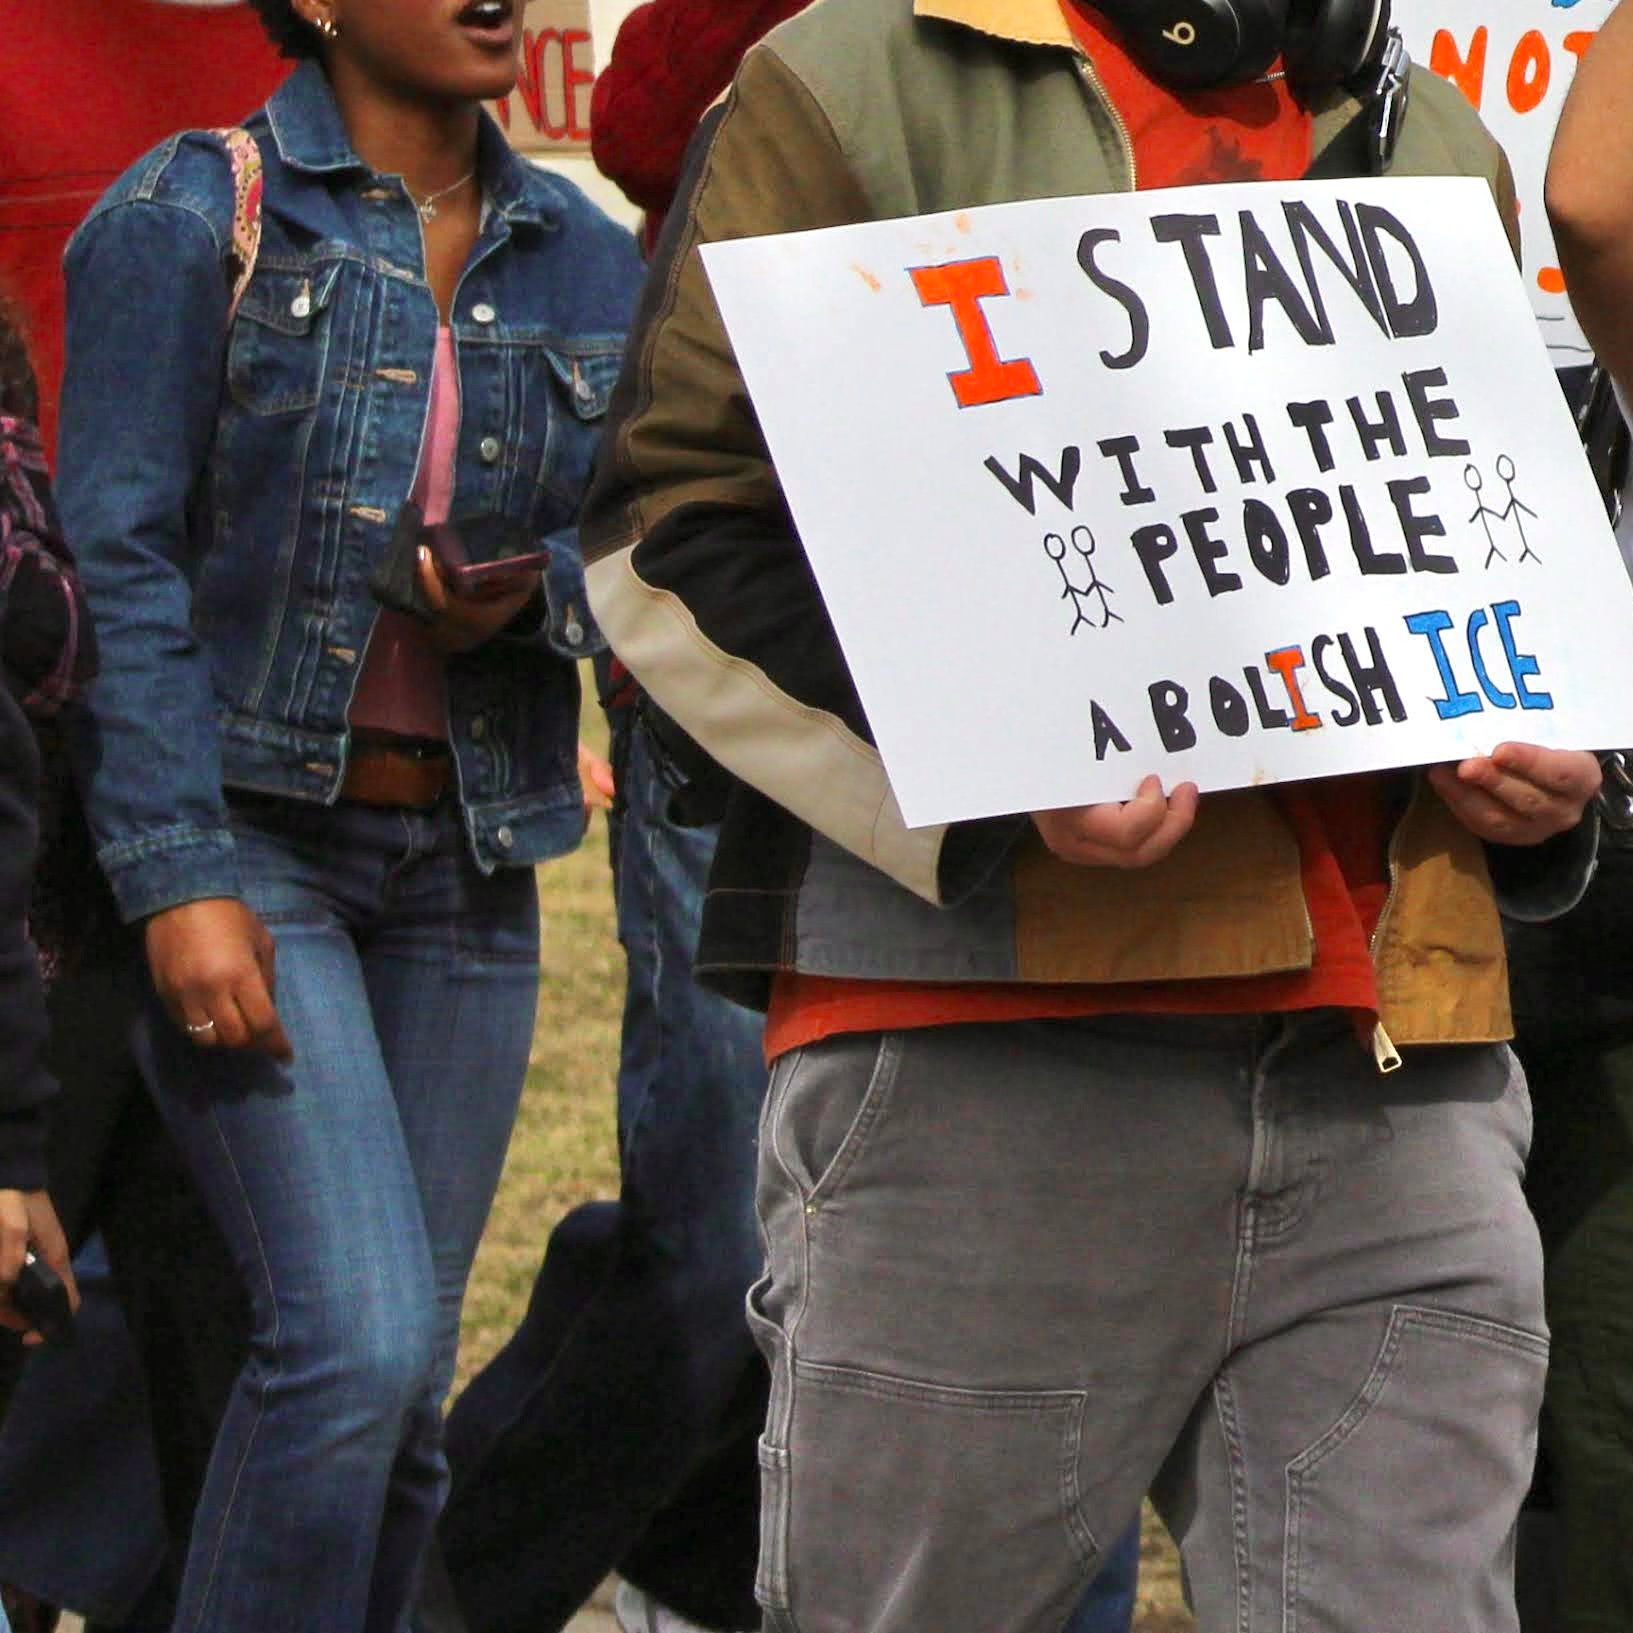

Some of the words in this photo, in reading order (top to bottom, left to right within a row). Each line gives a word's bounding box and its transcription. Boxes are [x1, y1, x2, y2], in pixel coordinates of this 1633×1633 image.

[905, 255, 1043, 410] I
[1076, 199, 1439, 370] STAND
[983, 412, 1277, 518] WITH
[1287, 366, 1471, 473] THE
[1130, 475, 1460, 607] PEOPLE
[1093, 626, 1408, 761] ABOLISH
[1402, 600, 1554, 722] ICE
